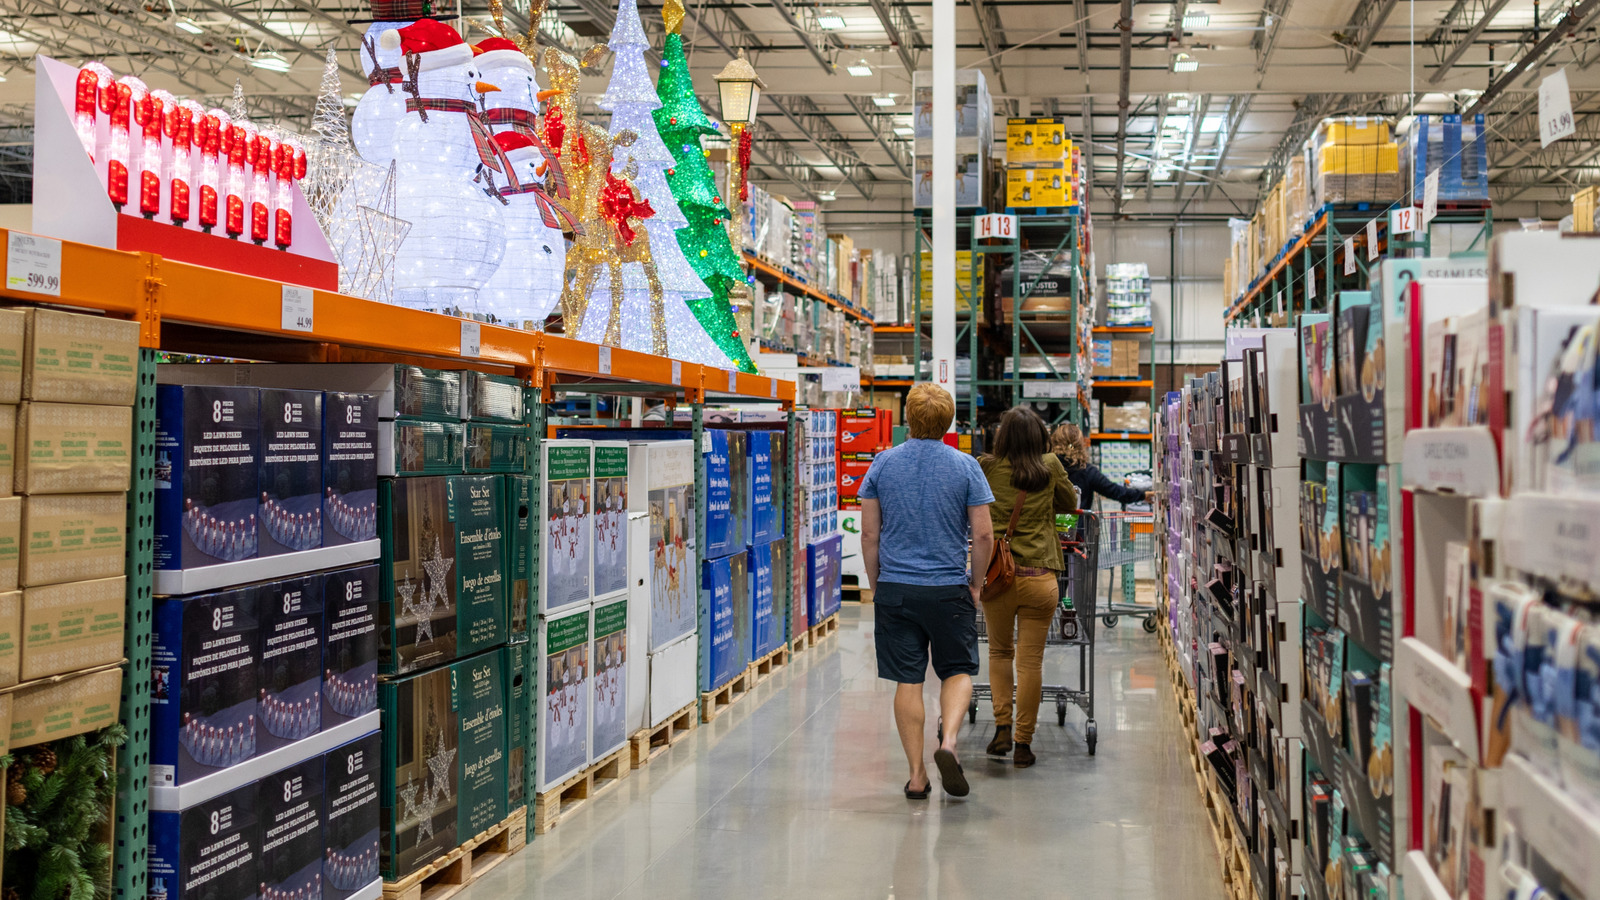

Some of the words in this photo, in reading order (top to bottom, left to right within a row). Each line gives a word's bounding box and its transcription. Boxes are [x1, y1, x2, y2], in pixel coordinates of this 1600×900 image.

[1548, 112, 1571, 137] 13.99
[981, 217, 991, 236] 14
[998, 216, 1011, 236] 13
[1398, 210, 1411, 231] 12
[27, 272, 59, 291] 599.99
[297, 316, 312, 329] 44.99
[213, 400, 221, 423] 8
[284, 402, 291, 423] 8
[346, 405, 352, 424] 8
[194, 445, 212, 453] PIQUETS
[448, 481, 454, 501] 3
[470, 485, 481, 499] Star
[482, 485, 490, 498] Set
[460, 530, 484, 544] Ensemble
[346, 582, 353, 601] 8
[462, 575, 476, 592] Juego
[476, 572, 484, 585] de
[283, 593, 290, 614] 8
[213, 608, 221, 631] 8
[275, 623, 283, 631] LED
[283, 621, 294, 629] LAWN
[295, 618, 308, 626] STAKES
[203, 641, 212, 649] LED
[212, 638, 225, 647] LAWN
[226, 635, 241, 644] STAKES
[193, 654, 212, 666] PIQUETS
[212, 653, 218, 661] DE
[219, 648, 237, 659] PELOUSE
[452, 669, 457, 690] 3
[472, 668, 482, 682] Star
[482, 664, 491, 678] Set
[462, 712, 485, 732] Ensemble
[348, 755, 353, 774] 8
[464, 761, 477, 780] Juego
[478, 755, 484, 767] de
[284, 780, 291, 802] 8
[284, 807, 295, 818] LAWN
[296, 801, 309, 813] STAKES
[211, 811, 219, 835] 8
[201, 845, 210, 856] LED
[211, 840, 224, 852] LAWN
[224, 833, 240, 846] STAKES
[191, 859, 210, 876] PIQUETS
[210, 856, 217, 866] DE
[218, 848, 236, 863] PELOUSE
